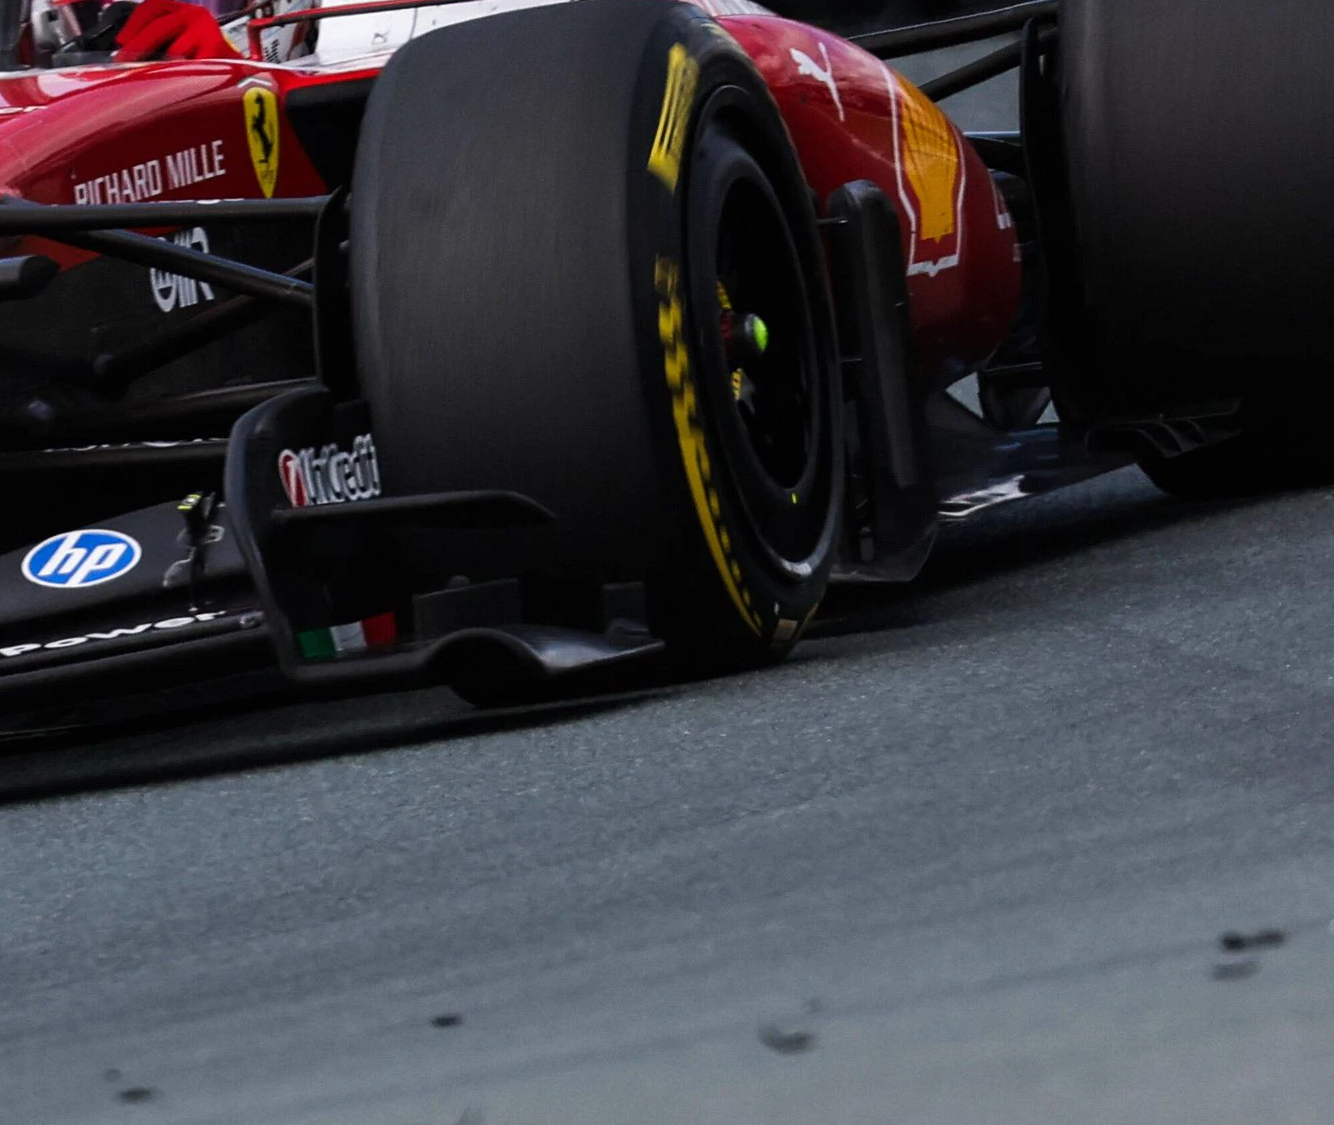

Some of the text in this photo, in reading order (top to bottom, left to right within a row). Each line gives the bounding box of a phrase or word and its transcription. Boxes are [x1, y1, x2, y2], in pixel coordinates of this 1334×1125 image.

[74, 139, 226, 205] RICHARD MILLE
[35, 529, 129, 588] hp
